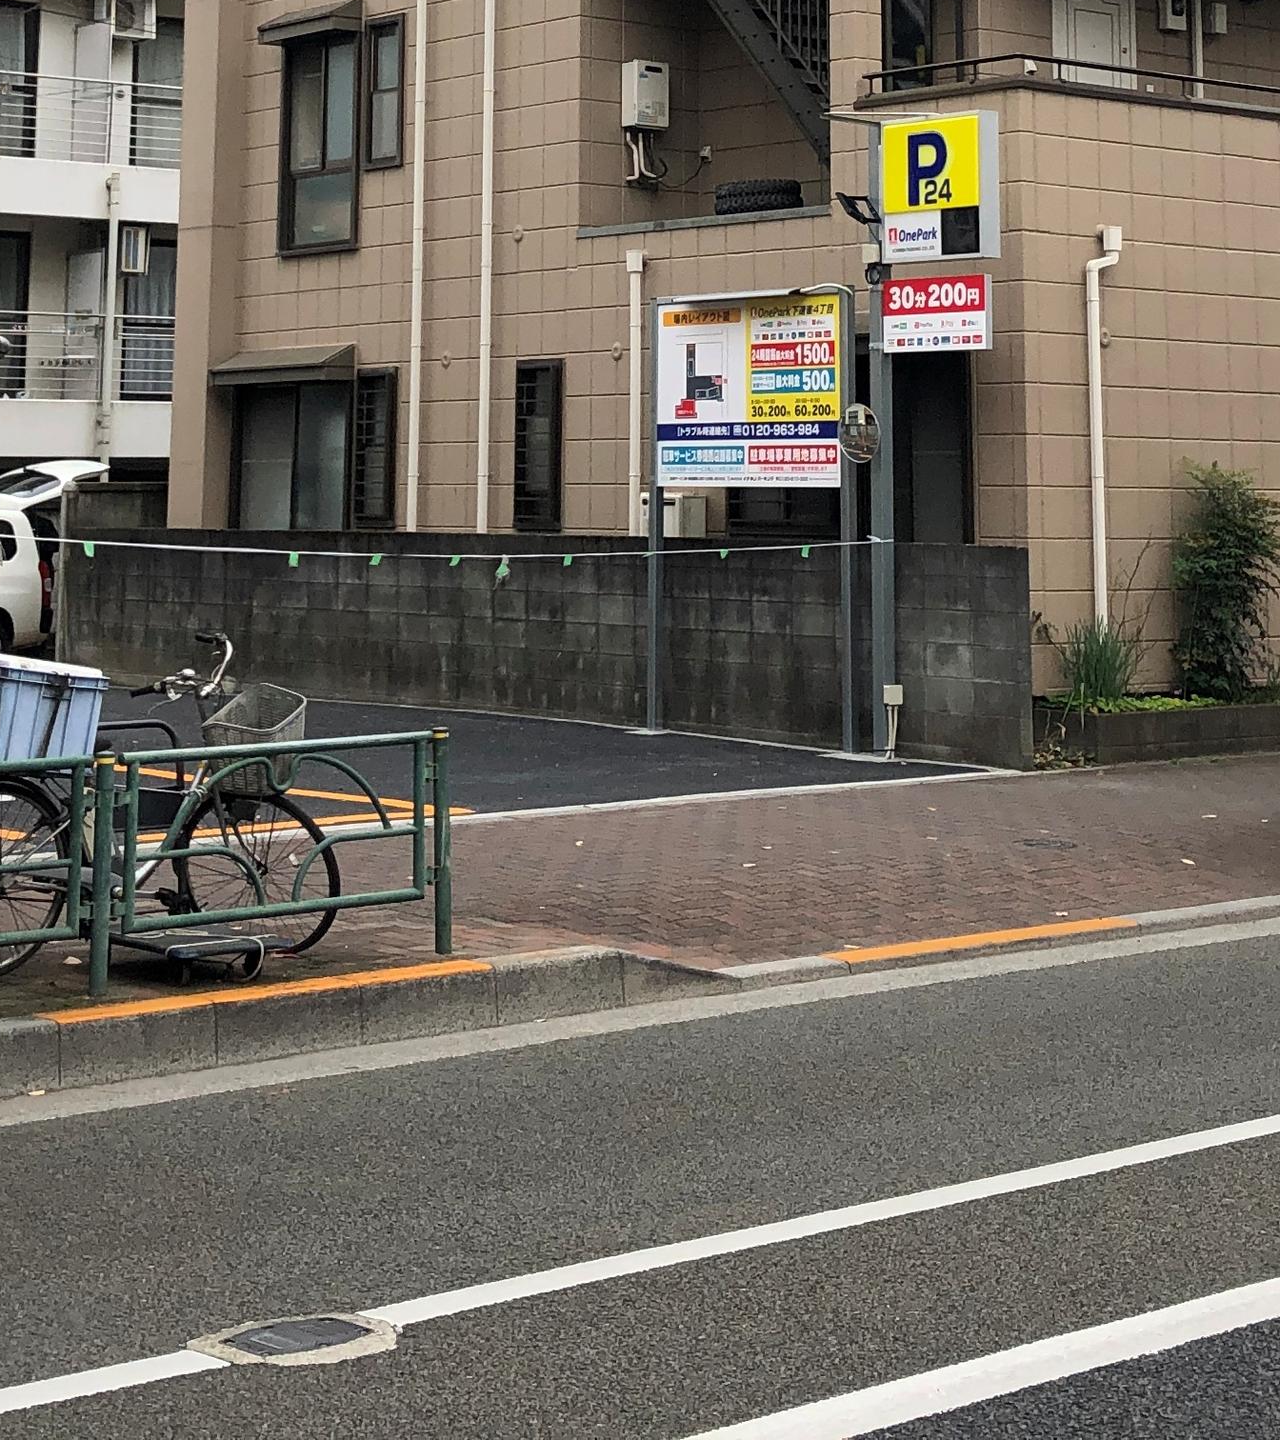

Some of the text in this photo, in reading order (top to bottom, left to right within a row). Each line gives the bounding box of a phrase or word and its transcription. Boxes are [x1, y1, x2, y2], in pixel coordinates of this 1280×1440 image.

[907, 131, 948, 207] P
[924, 178, 952, 205] 24
[898, 227, 938, 242] OnePark
[888, 282, 980, 310] 30分200円
[742, 423, 820, 436] 0120-963-984
